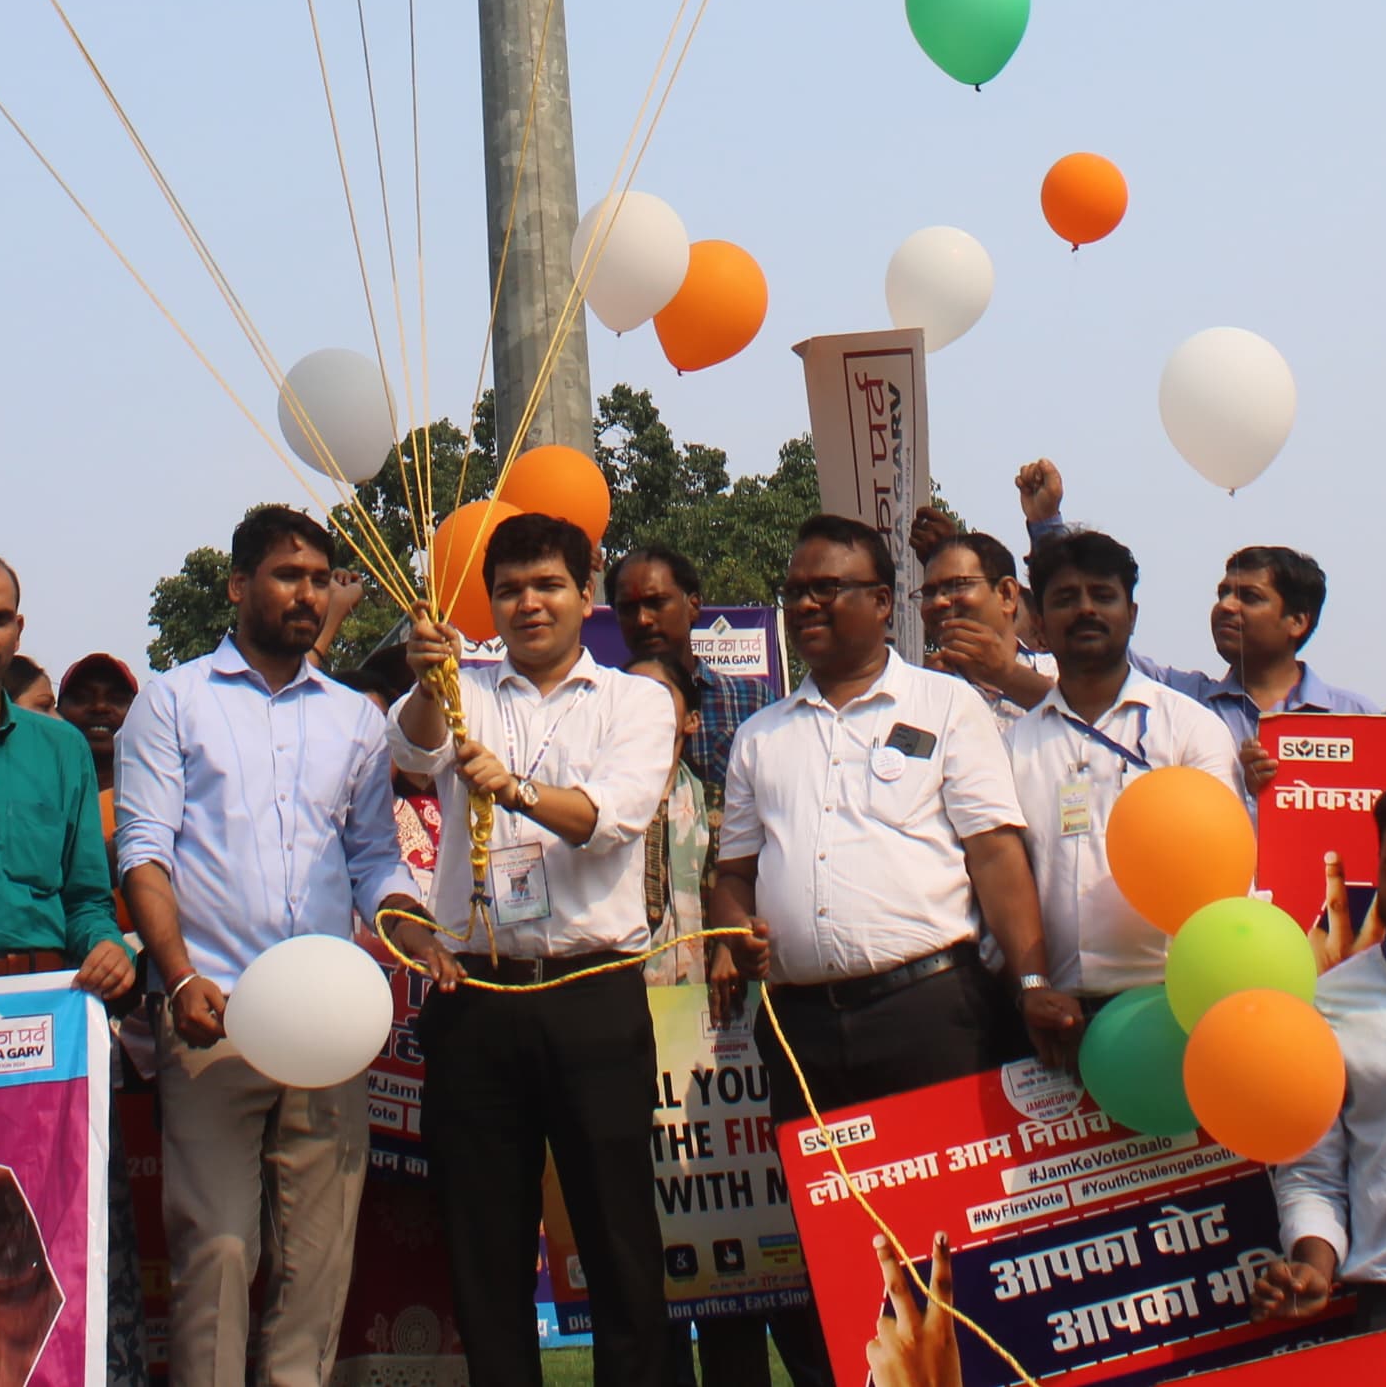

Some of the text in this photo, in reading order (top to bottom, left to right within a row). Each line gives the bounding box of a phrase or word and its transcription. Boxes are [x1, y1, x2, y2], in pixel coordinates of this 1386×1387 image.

[888, 382, 904, 503] GARV
[717, 654, 761, 664] KA GARV
[718, 636, 762, 653] का पर्व
[1282, 740, 1351, 760] SWEEP
[7, 1045, 44, 1060] GARV
[18, 1020, 48, 1044] पर्व
[651, 1121, 714, 1162] THE
[805, 1106, 1111, 1206] लोकसभा आम निर्वाच
[1028, 1135, 1173, 1185] #JamKeVoteDaalo
[656, 1170, 754, 1215] WITH
[973, 1149, 1236, 1225] #MyFirstVote #YouthChalengeBooth
[989, 1229, 1141, 1301] आपका
[1149, 1204, 1230, 1255] वोट
[696, 1291, 778, 1317] office, East
[1047, 1276, 1200, 1352] आपका
